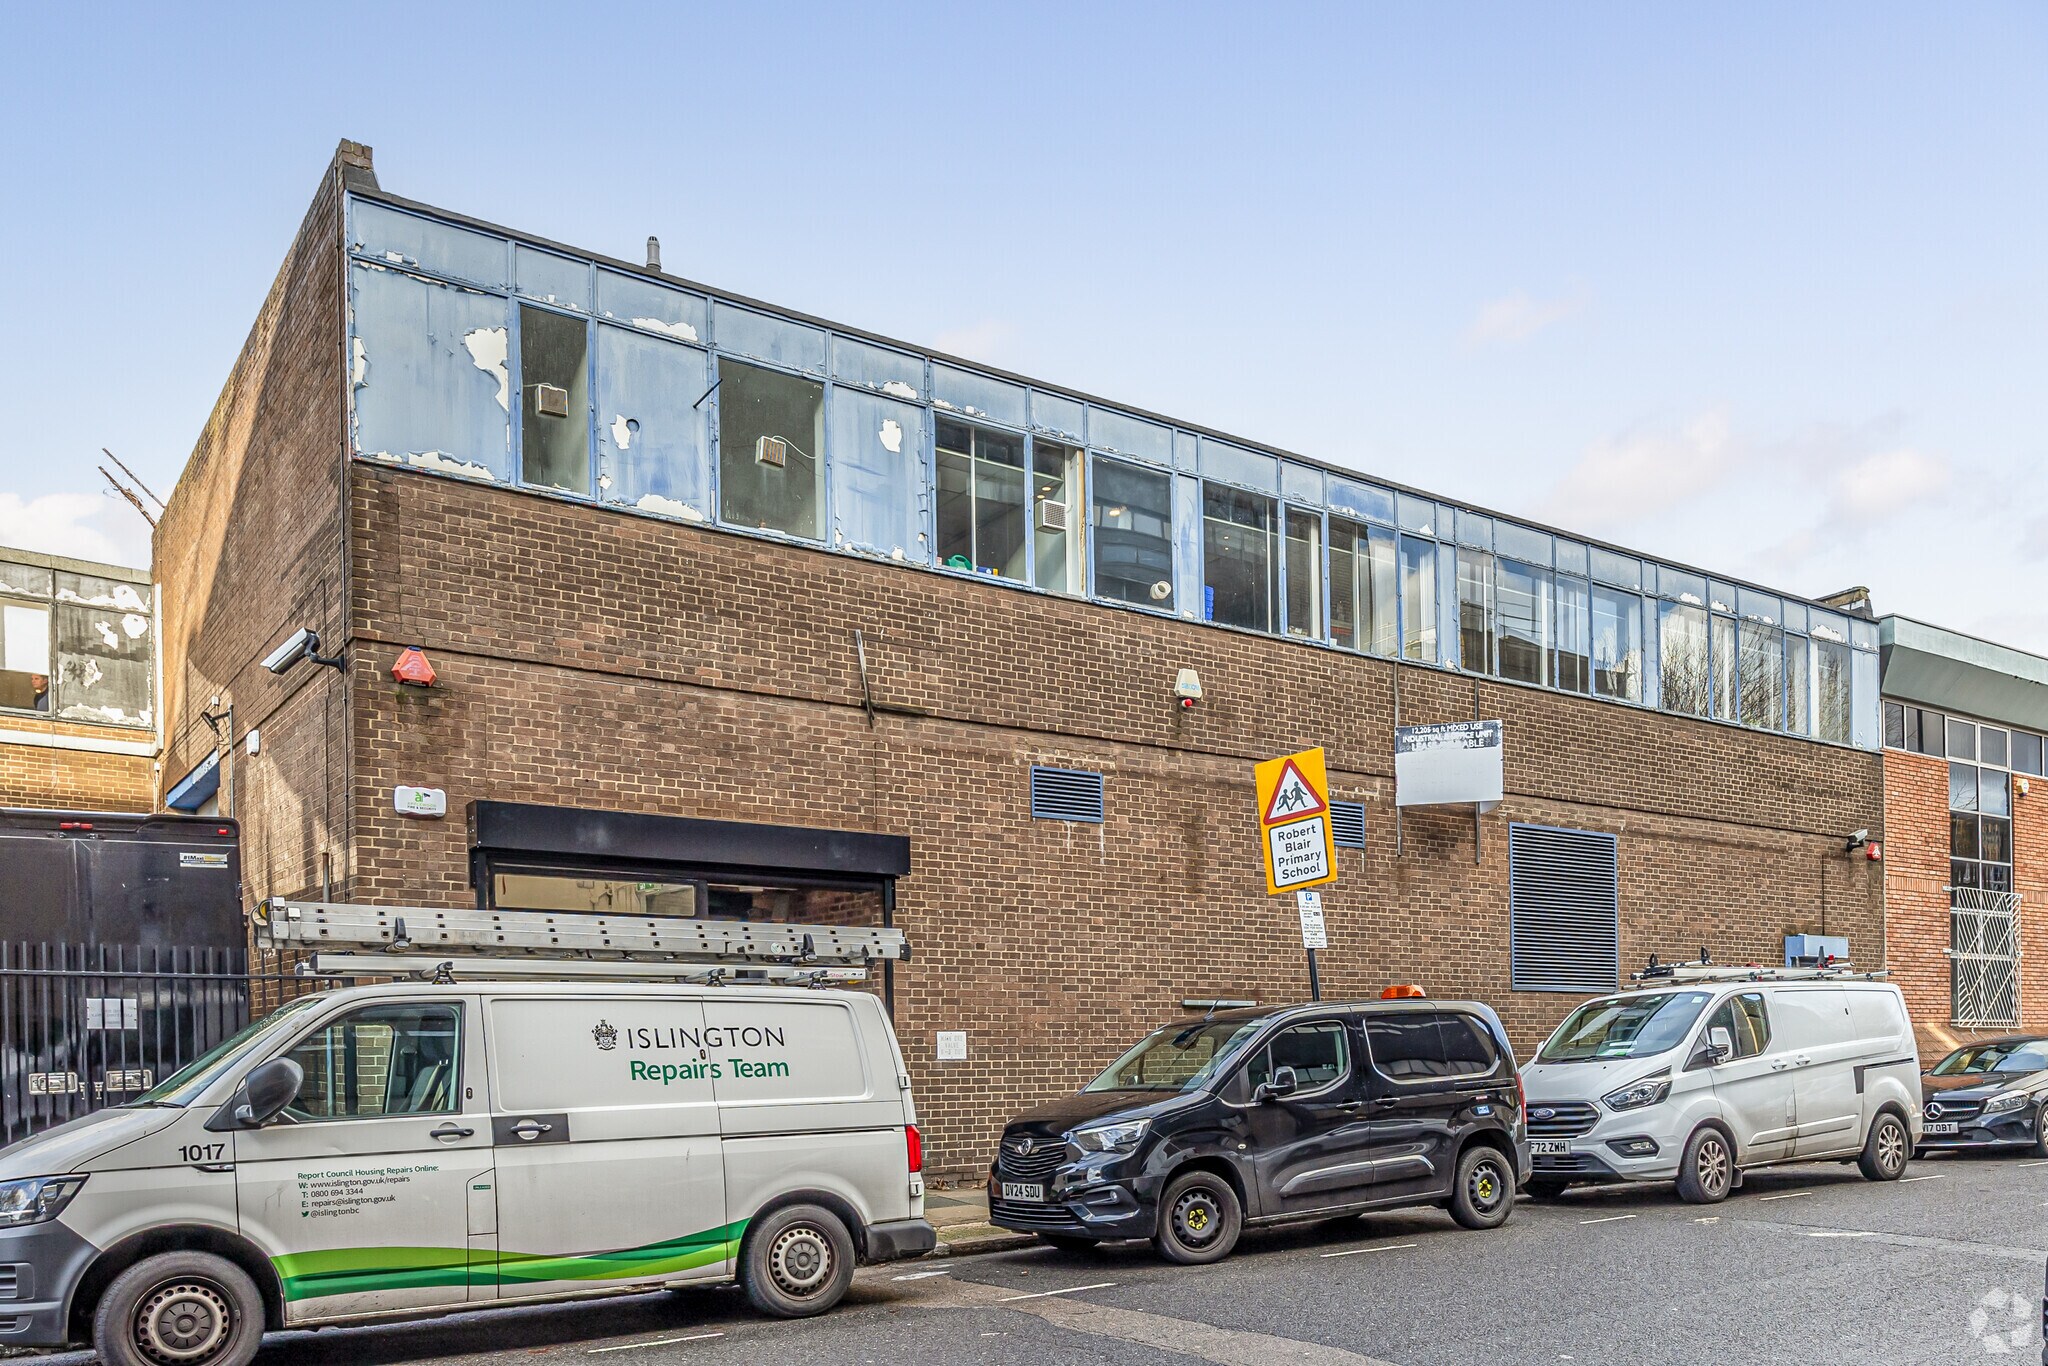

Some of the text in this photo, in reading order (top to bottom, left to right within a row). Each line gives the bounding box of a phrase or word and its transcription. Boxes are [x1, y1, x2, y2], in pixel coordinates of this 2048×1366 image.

[1446, 723, 1469, 732] MIXED
[1470, 722, 1484, 730] USE
[1475, 729, 1493, 739] UNIT
[1277, 824, 1316, 841] Robert
[1285, 839, 1311, 852] Blair
[1278, 851, 1321, 867] Primary
[1282, 862, 1321, 879] School
[627, 1027, 785, 1049] ISLINGTON
[630, 1058, 790, 1086] Repairs Team
[178, 1143, 225, 1162] 1017
[1548, 1142, 1566, 1153] ZWH
[298, 1164, 439, 1181] Report Council Housing Repairs Online:
[310, 1175, 411, 1188] www.islington.gov.uk/repairs
[310, 1190, 329, 1198] 0800
[330, 1189, 344, 1197] 694
[1005, 1184, 1040, 1198] DV24 SDU
[301, 1194, 396, 1208] E: repairs@islington.gov.uk
[310, 1207, 360, 1218] @islingtonbc
